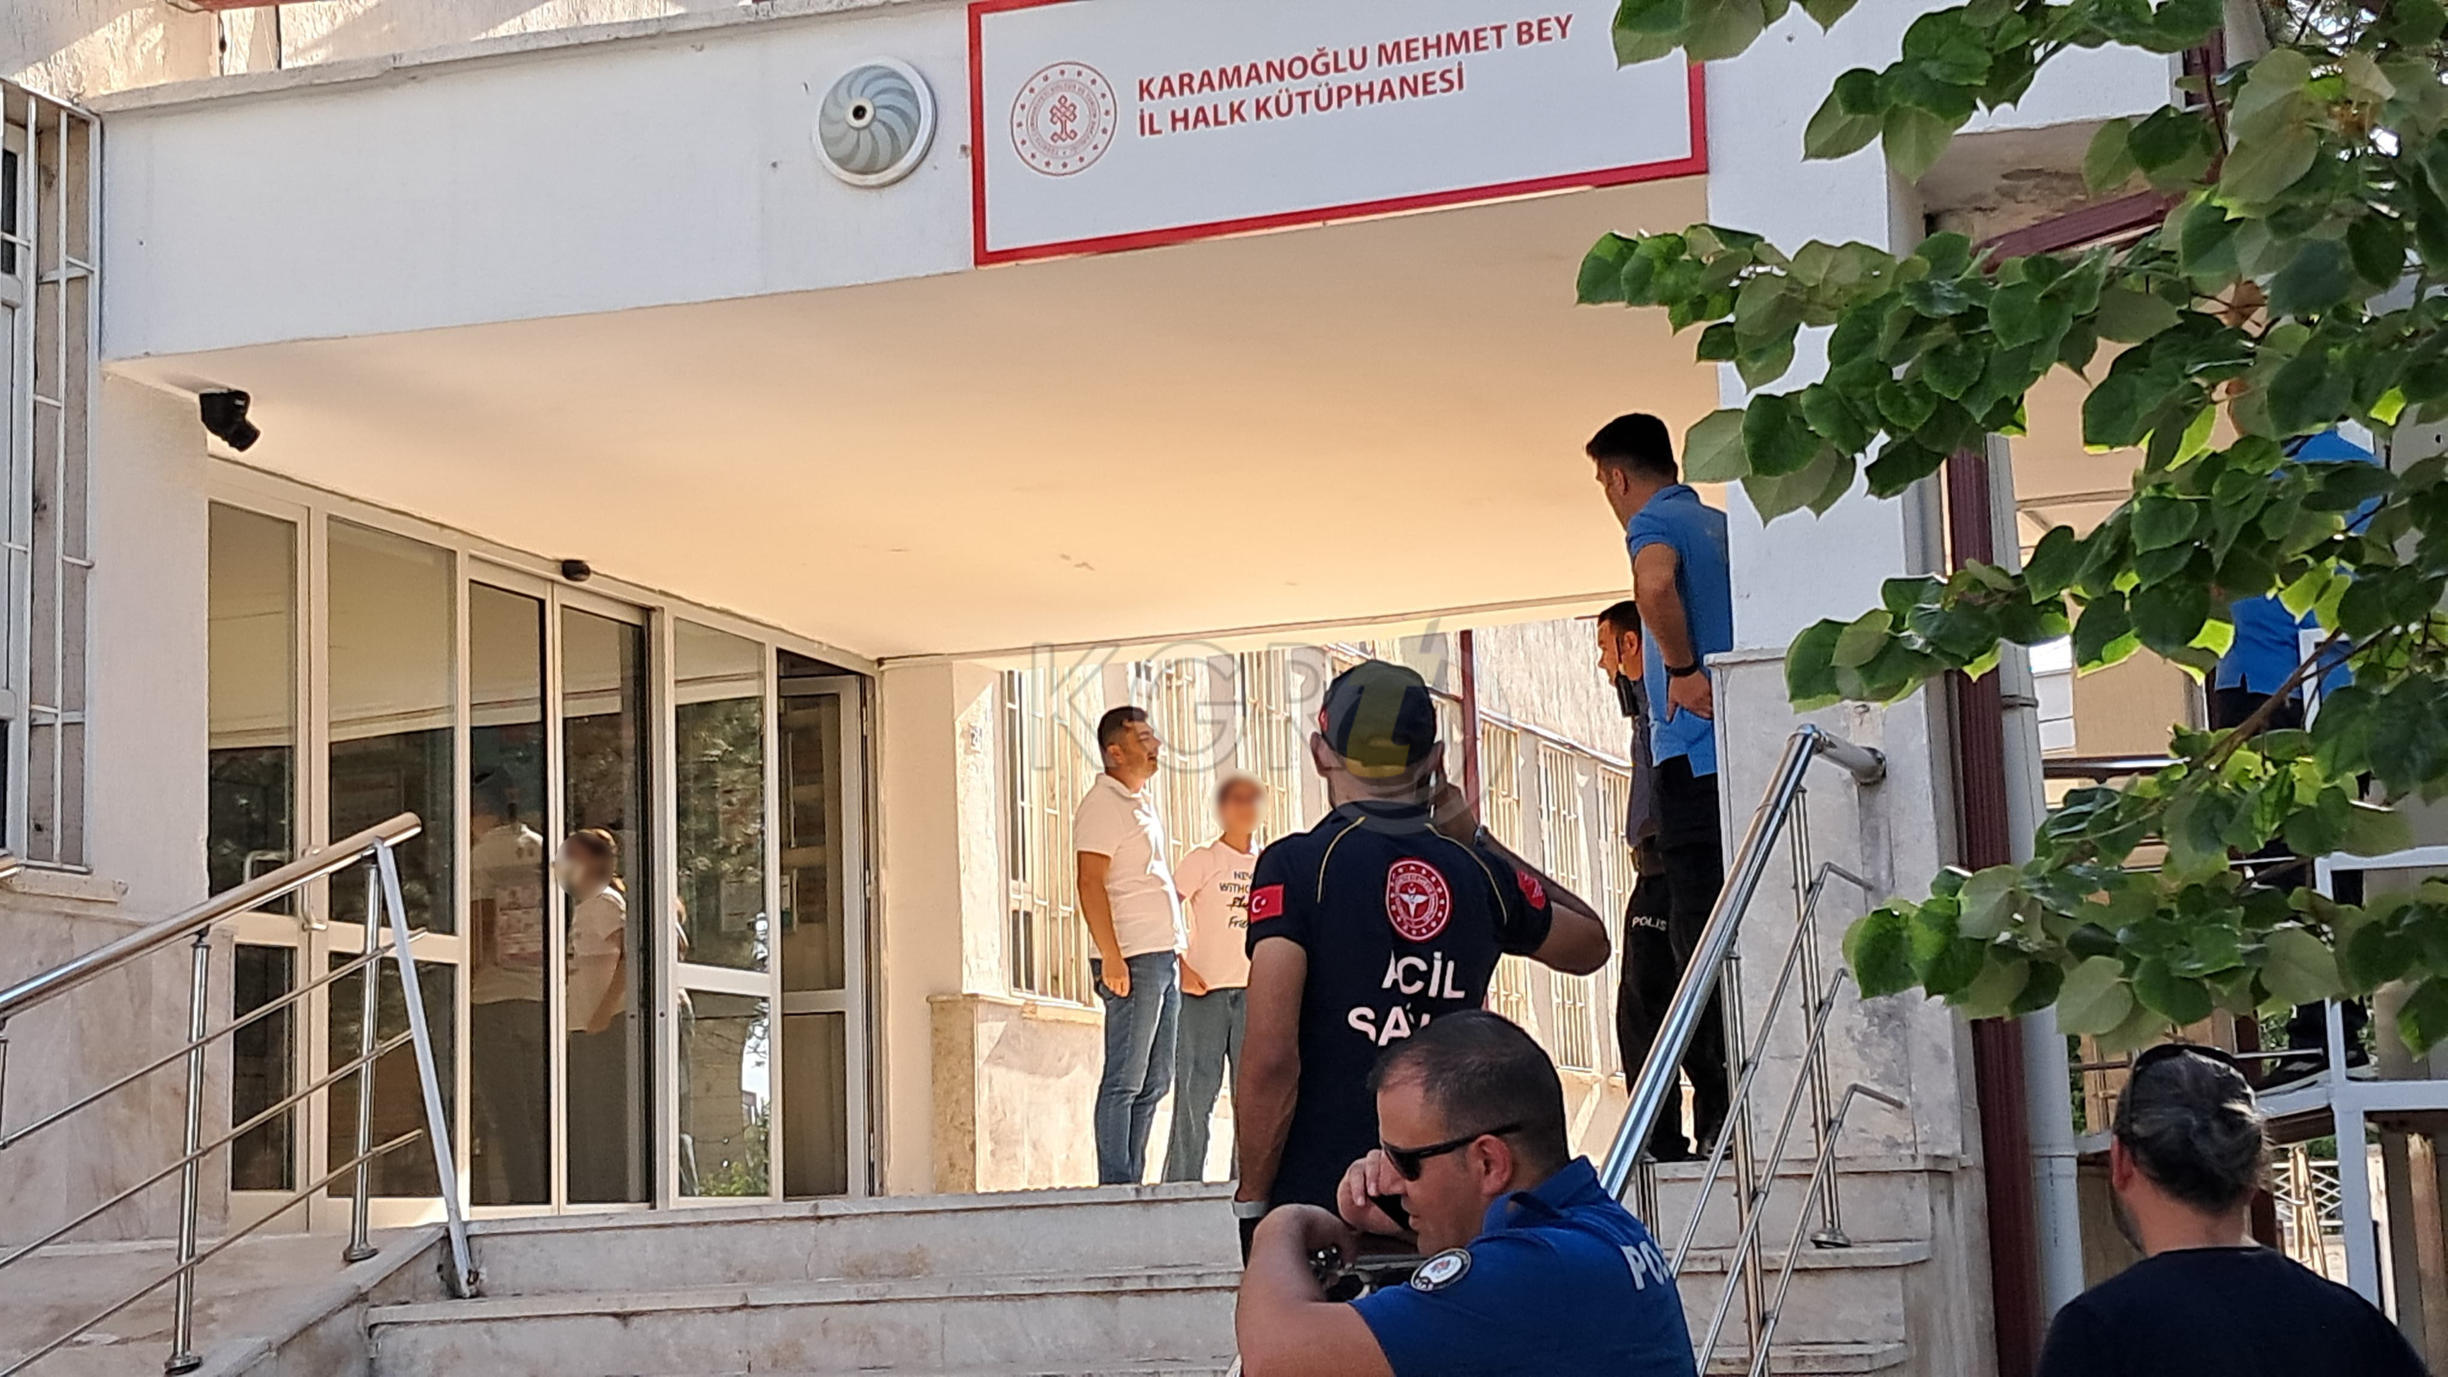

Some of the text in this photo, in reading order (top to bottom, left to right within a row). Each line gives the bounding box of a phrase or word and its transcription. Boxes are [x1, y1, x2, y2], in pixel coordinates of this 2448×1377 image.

[1137, 13, 1573, 102] KARAMANOĞLU MEHMET BEY
[1138, 107, 1163, 137] İL
[1169, 99, 1248, 133] HALK
[1254, 60, 1464, 121] KÜTÜPHANESİ
